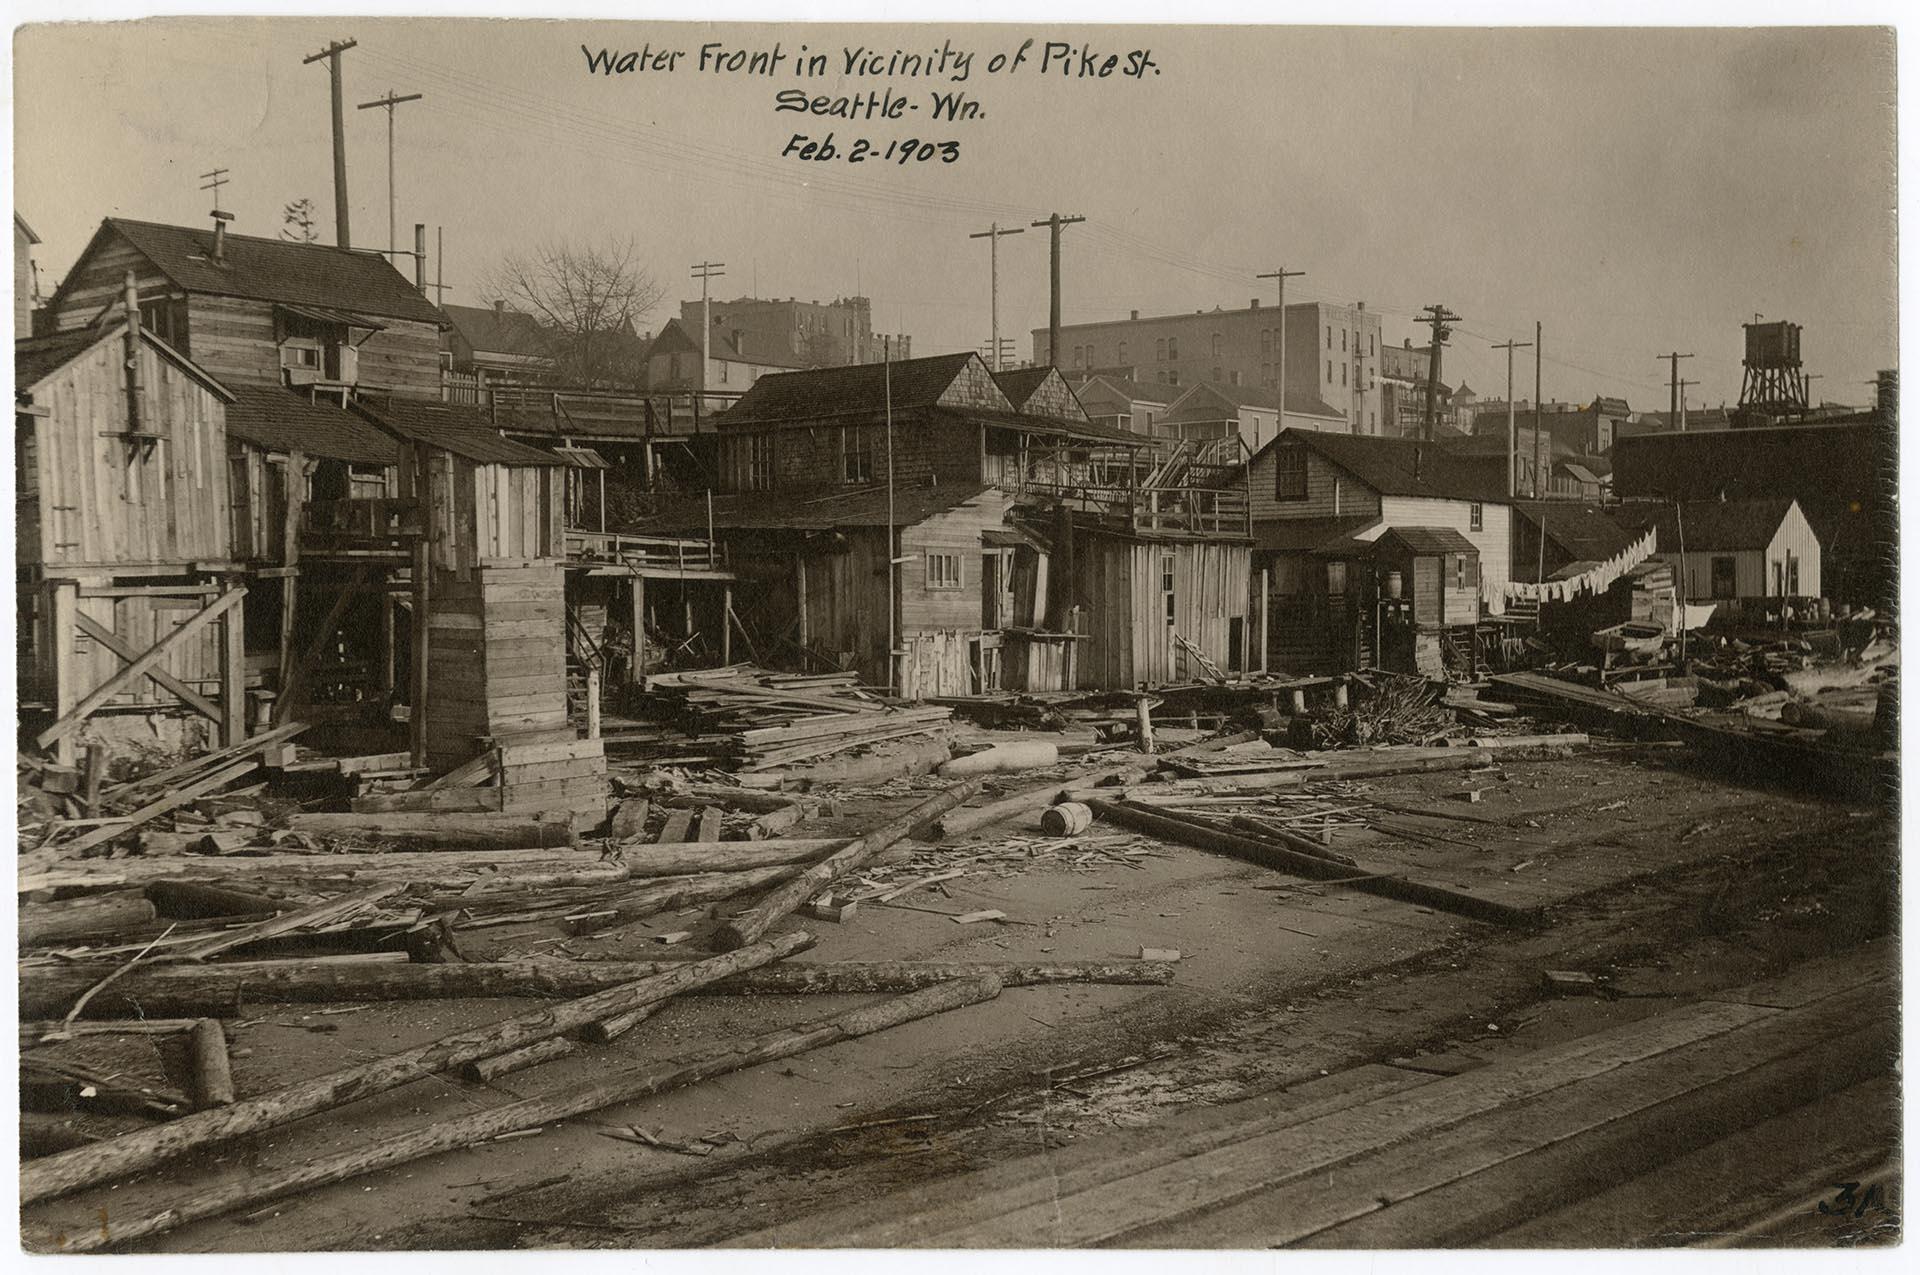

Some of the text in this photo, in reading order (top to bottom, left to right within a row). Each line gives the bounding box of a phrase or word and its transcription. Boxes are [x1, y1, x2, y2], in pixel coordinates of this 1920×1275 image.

[580, 38, 1162, 83] Water Front in Vicinity of Pike St.
[931, 92, 987, 122] Wn.
[780, 133, 961, 166] Feb. 2-1903
